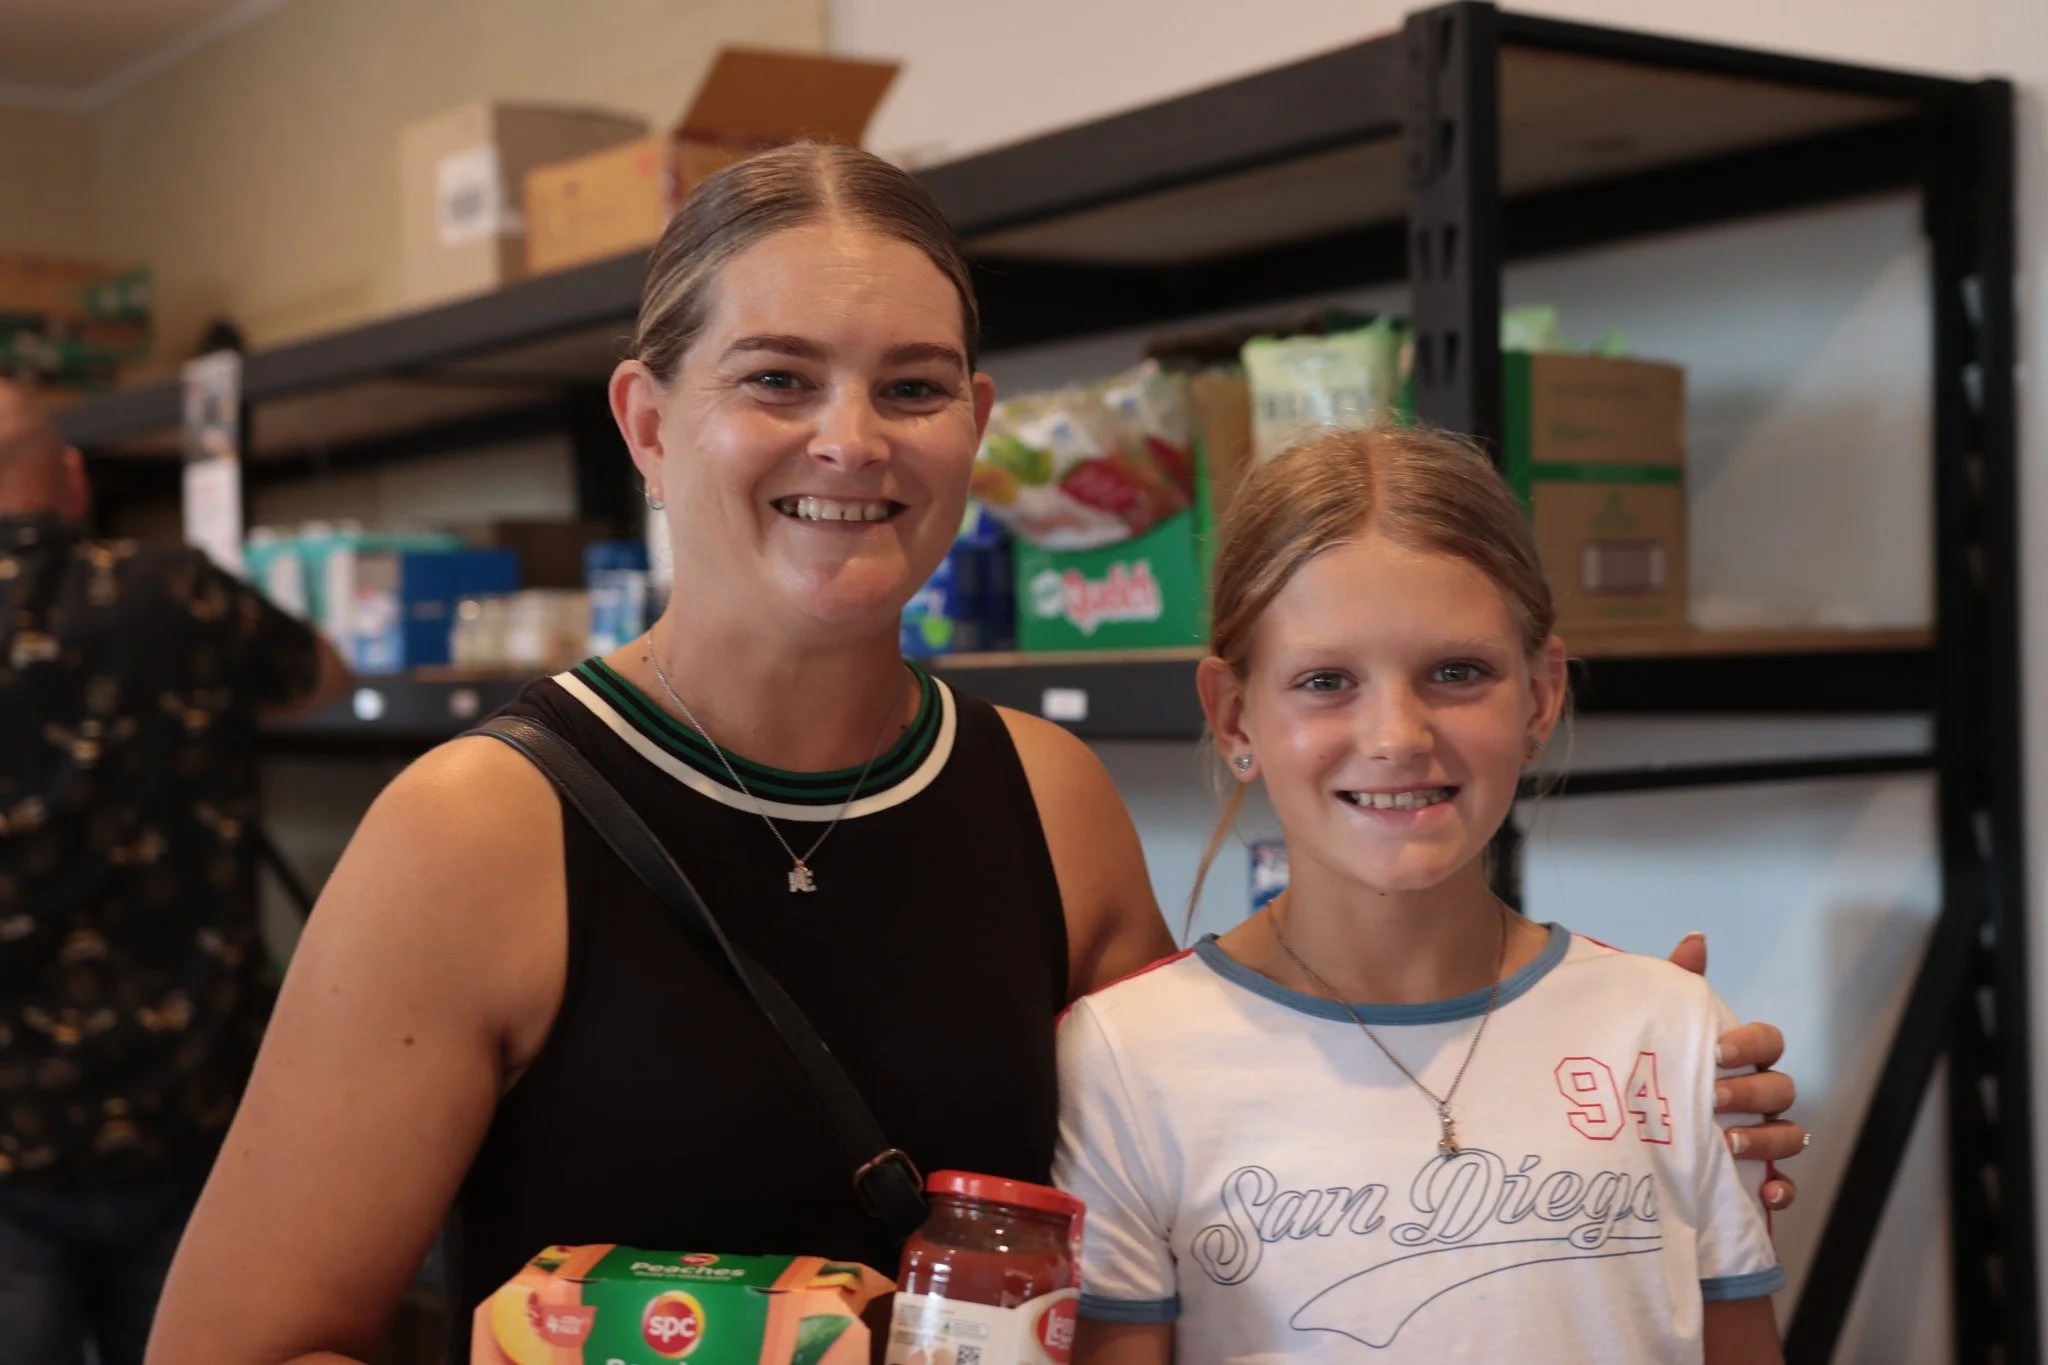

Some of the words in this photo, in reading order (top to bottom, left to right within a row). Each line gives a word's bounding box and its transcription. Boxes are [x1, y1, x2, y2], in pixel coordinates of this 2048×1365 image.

[1553, 1051, 1673, 1146] 94
[1190, 1165, 1389, 1286] San
[629, 1261, 747, 1277] Peaches
[648, 1314, 697, 1343] spc
